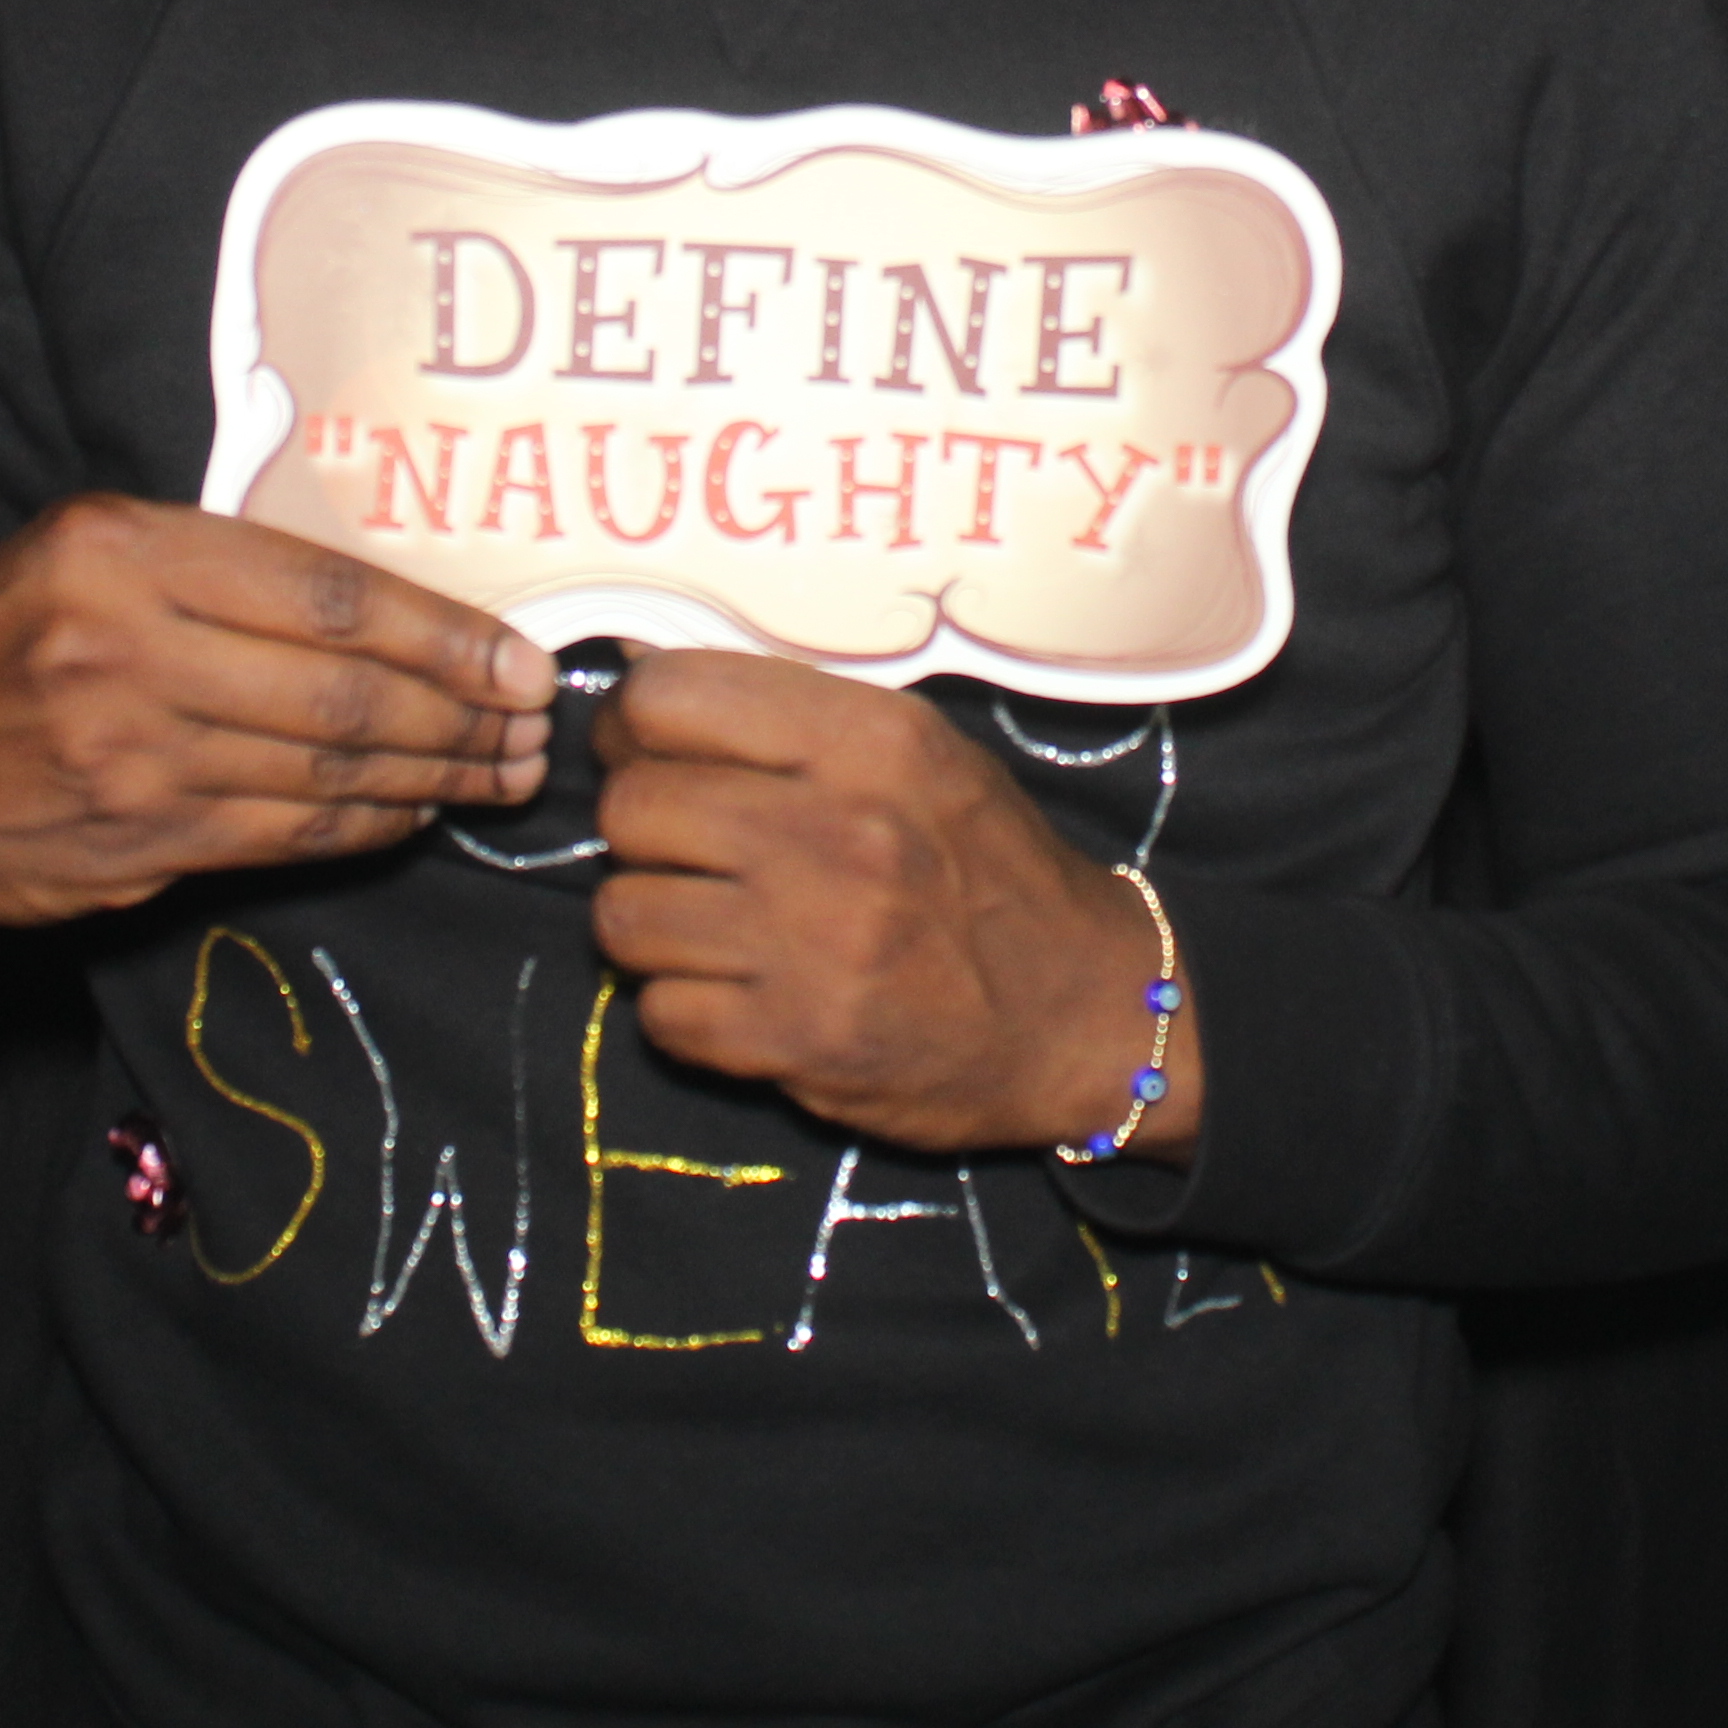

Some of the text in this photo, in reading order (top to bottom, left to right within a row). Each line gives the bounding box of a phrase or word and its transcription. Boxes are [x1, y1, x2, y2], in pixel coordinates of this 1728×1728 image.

[410, 229, 1133, 399] DEFINE
[304, 414, 1224, 552] "NAUGHTY"
[186, 925, 1287, 1357] SWEA
